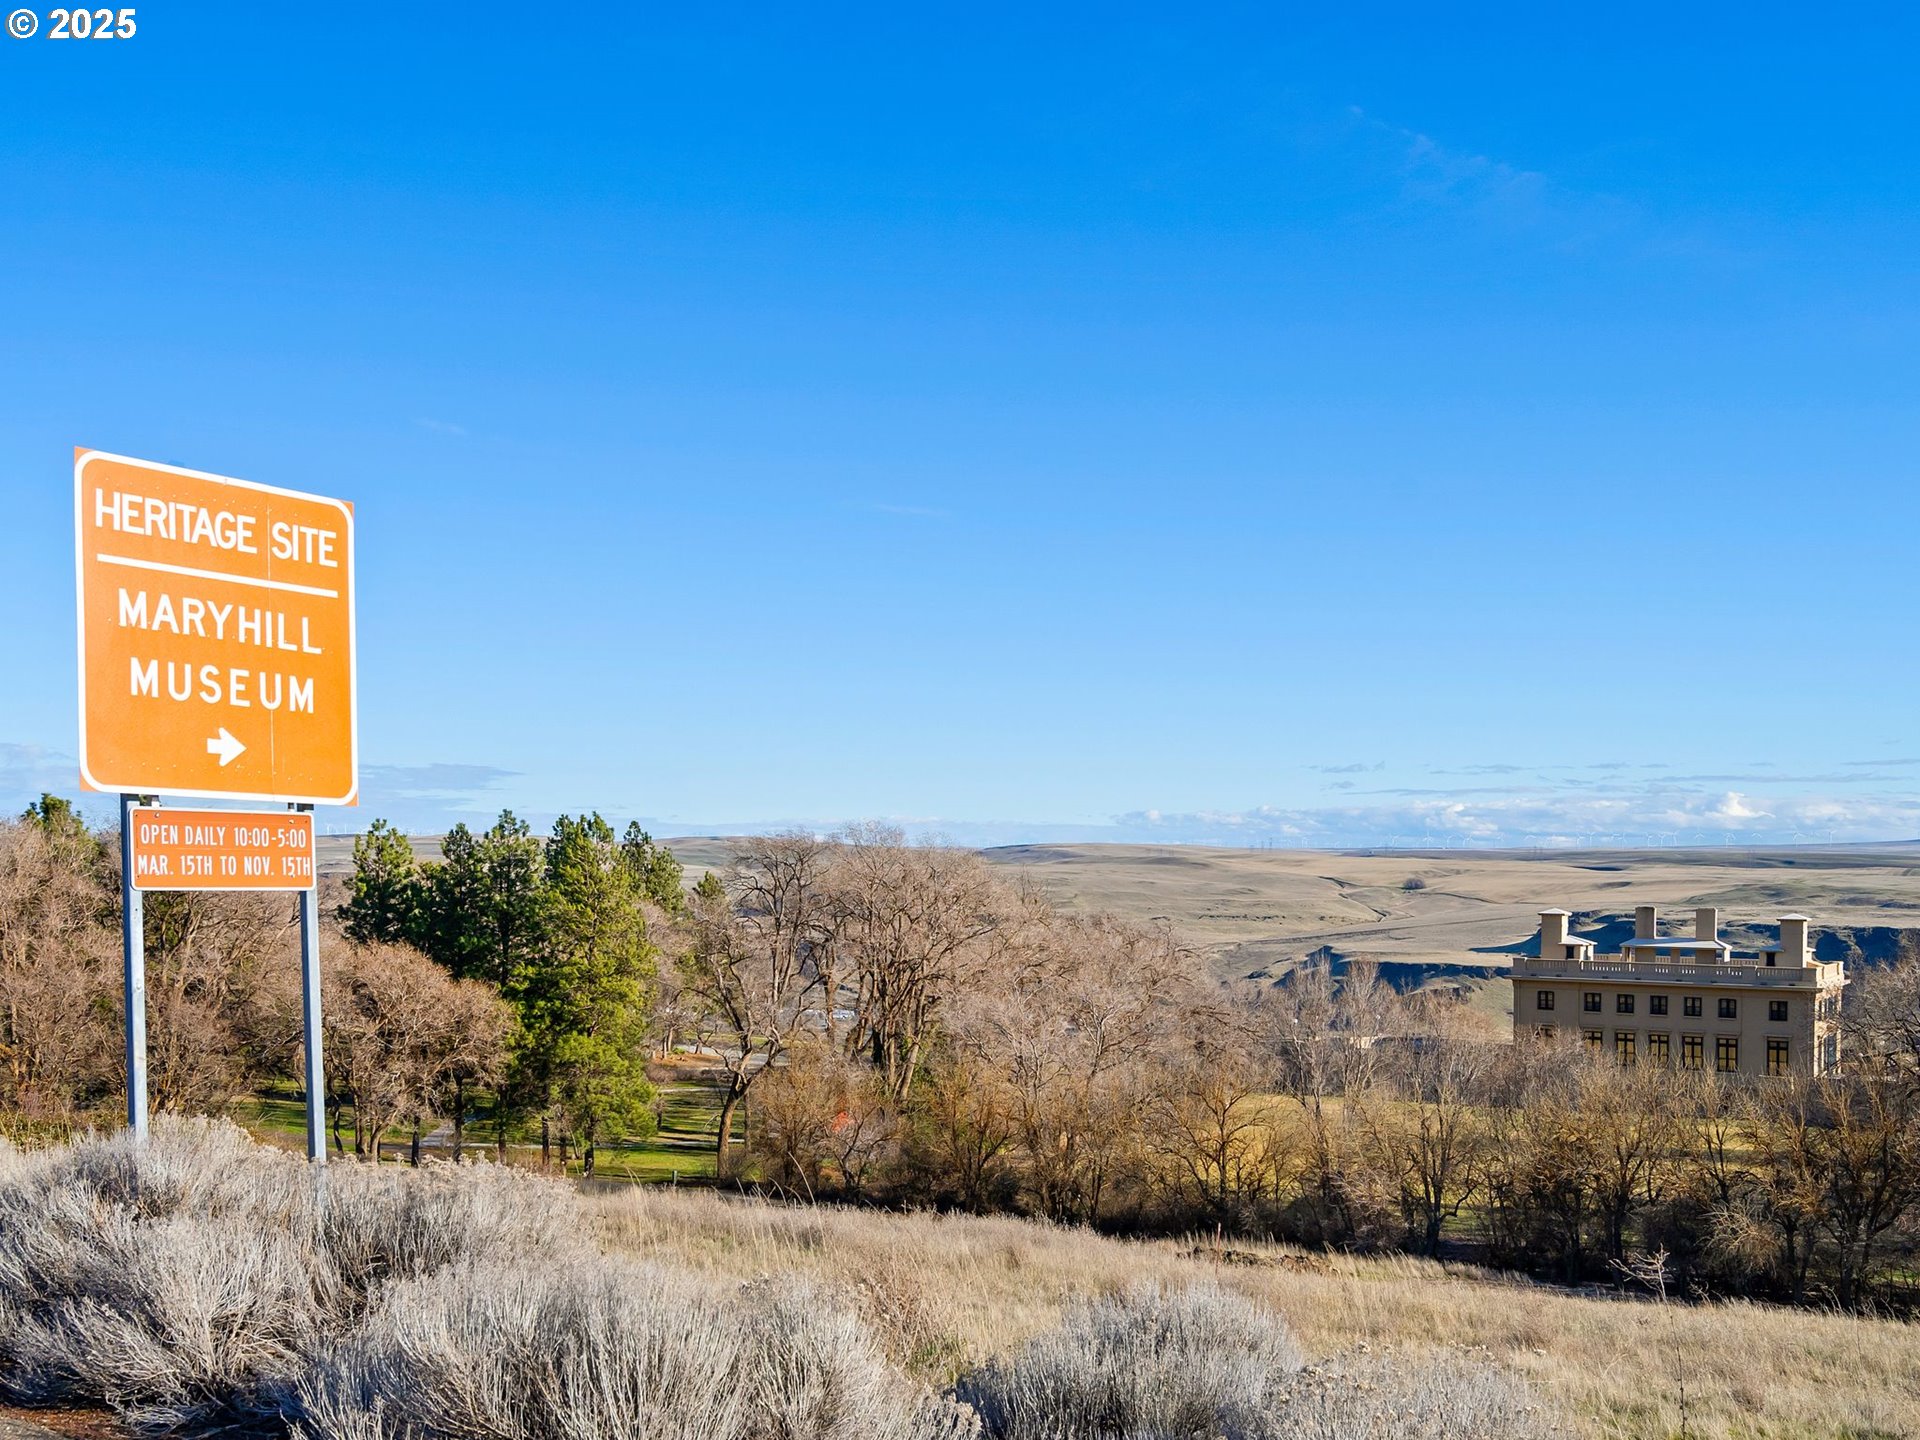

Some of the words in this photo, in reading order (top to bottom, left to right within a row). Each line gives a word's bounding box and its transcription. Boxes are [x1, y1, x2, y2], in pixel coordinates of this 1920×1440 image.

[95, 487, 258, 555] HERITAGE
[271, 521, 339, 568] SITE
[118, 587, 322, 655] MARYHILL
[130, 656, 314, 714] MUSEUM
[140, 823, 179, 846] OPEN
[184, 825, 227, 847] DAILY
[233, 826, 307, 849] 10:00-5:00
[137, 854, 174, 876] MAR.
[180, 855, 213, 876] 15TH
[219, 855, 237, 876] TO
[243, 855, 275, 876] NOV.
[281, 856, 311, 877] 15TH
